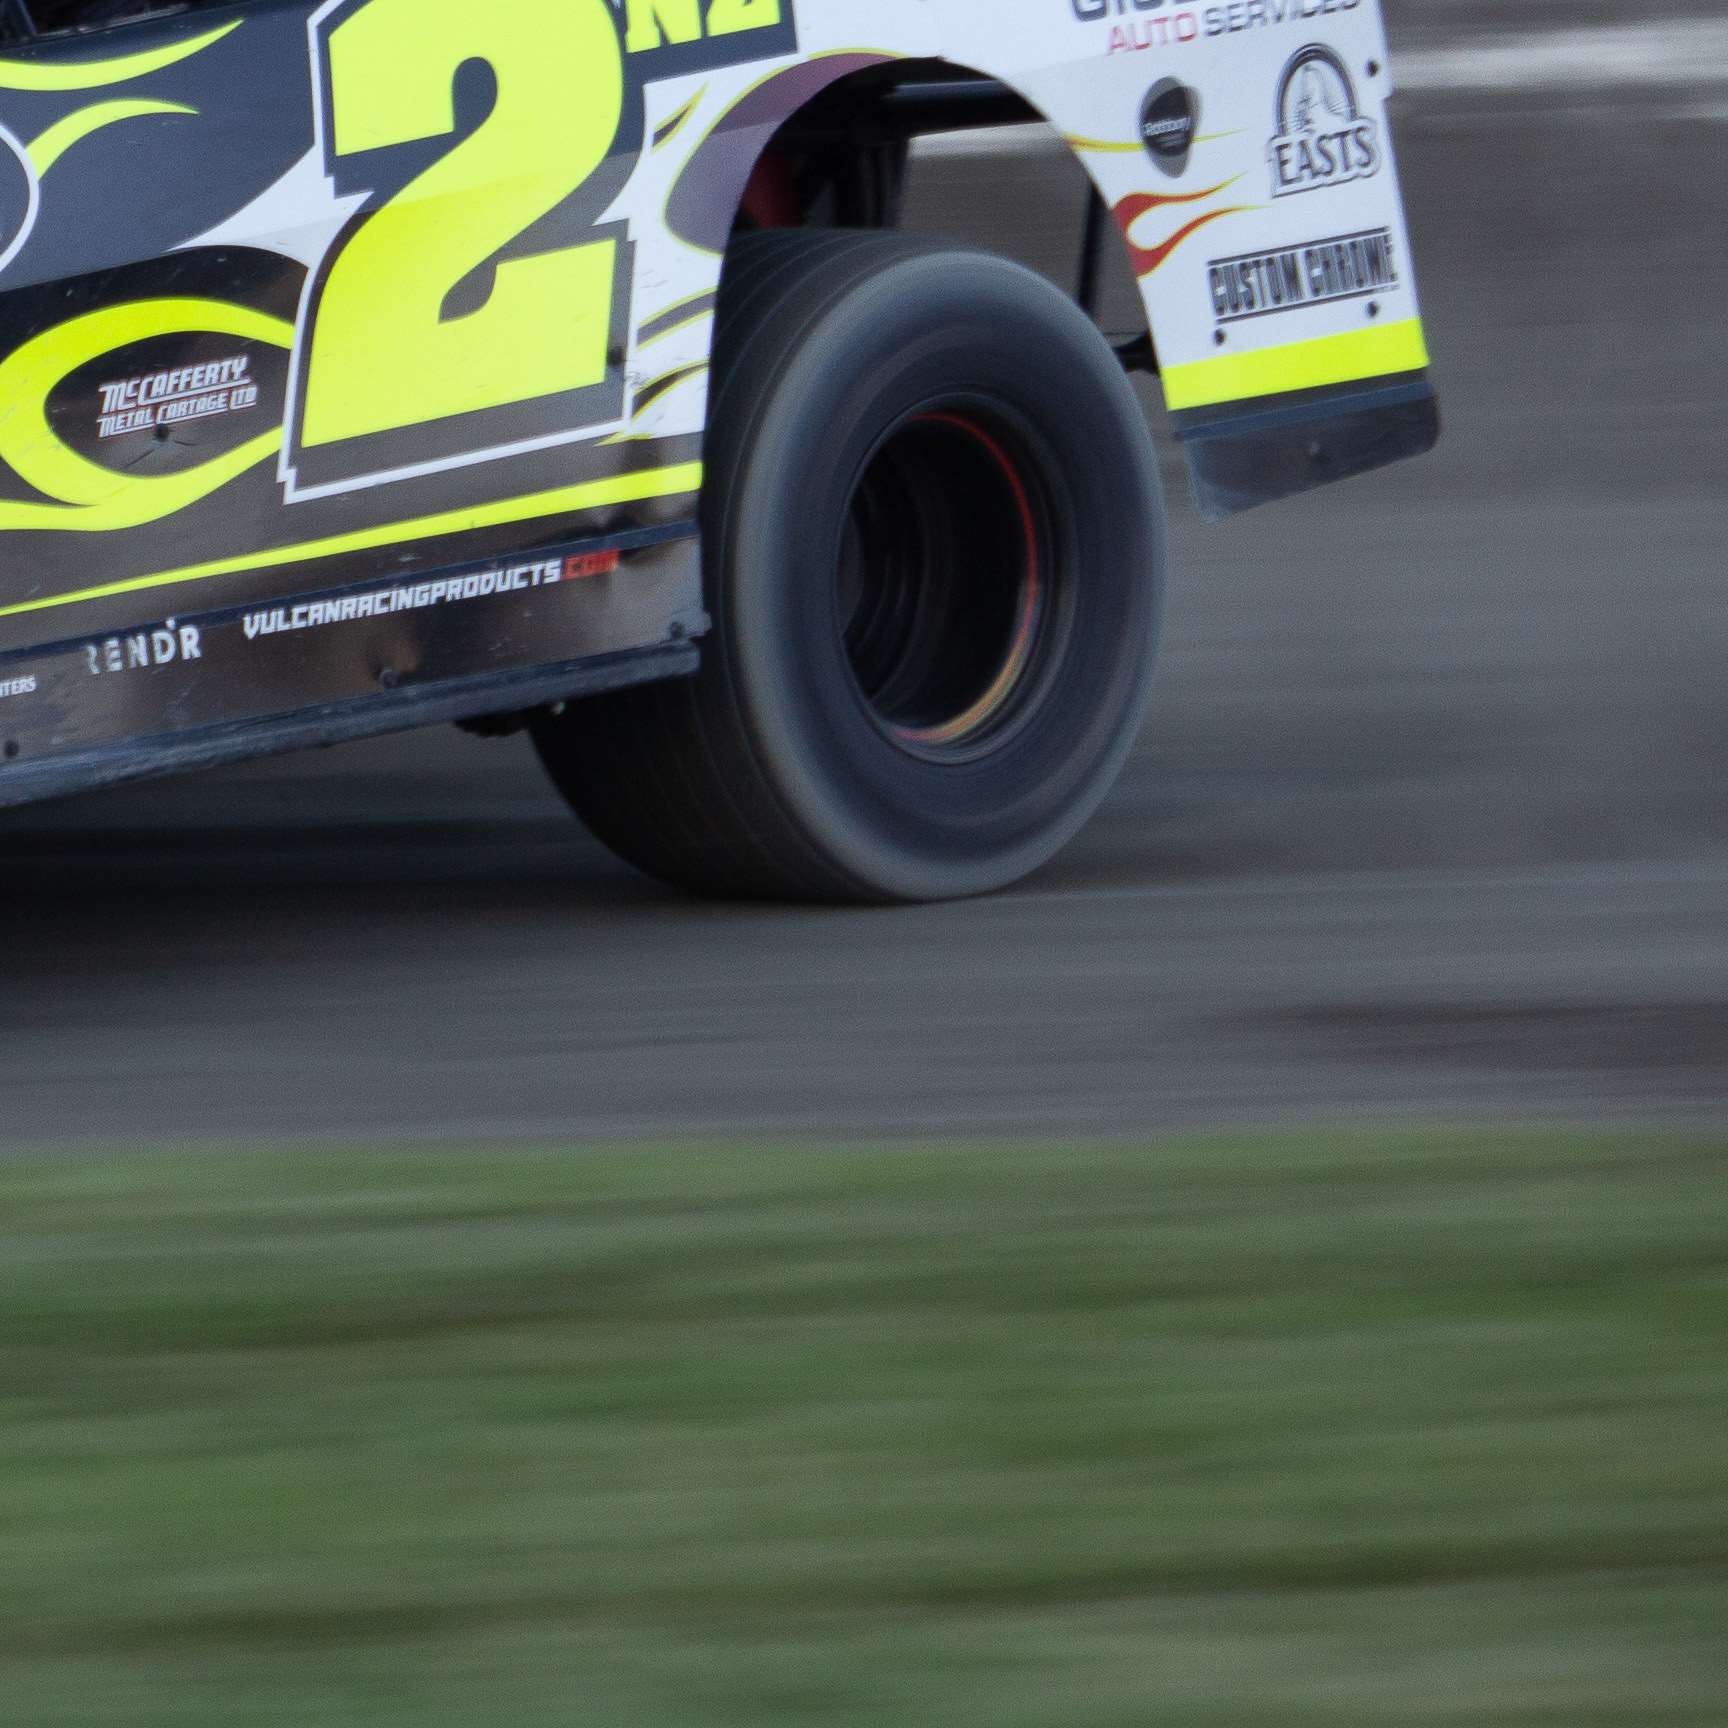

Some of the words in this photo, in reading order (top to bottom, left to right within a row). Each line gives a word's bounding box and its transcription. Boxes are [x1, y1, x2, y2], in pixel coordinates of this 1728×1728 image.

[1107, 12, 1197, 56] AUTO
[1273, 125, 1376, 187] EASTS
[1209, 250, 1306, 317] CUSTOM
